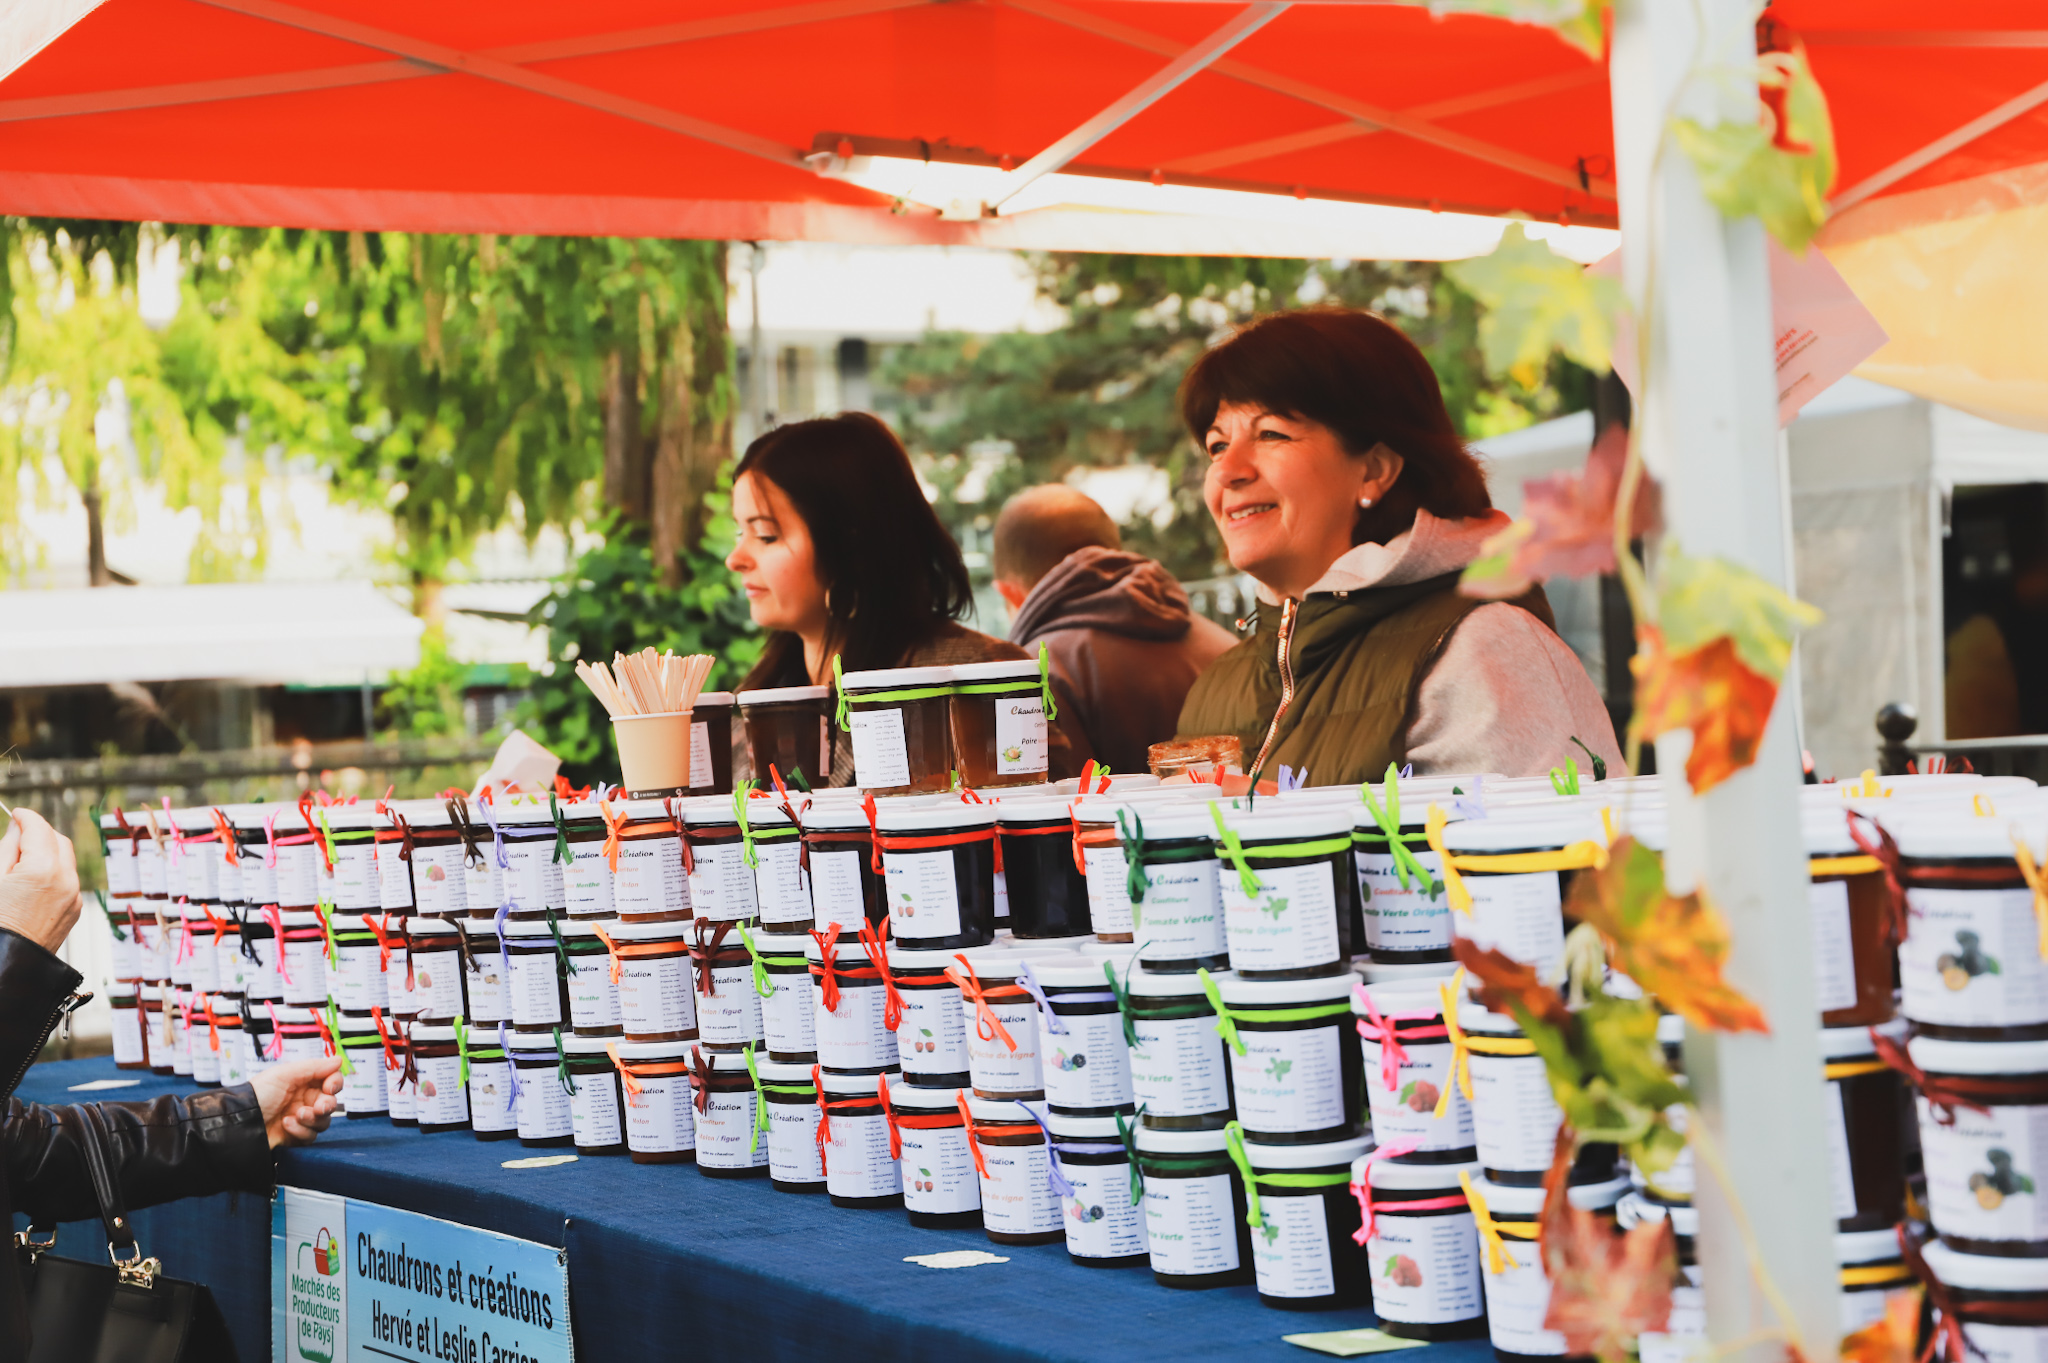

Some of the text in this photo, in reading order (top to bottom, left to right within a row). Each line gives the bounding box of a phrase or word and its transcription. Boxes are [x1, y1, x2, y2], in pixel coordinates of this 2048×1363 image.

[1022, 737, 1038, 745] Poire
[623, 848, 654, 858] Création
[1156, 874, 1199, 886] Création
[1374, 887, 1413, 896] Confiture
[1383, 908, 1410, 918] Verte
[1183, 914, 1215, 924] Verte
[1257, 925, 1293, 936] Origan
[624, 968, 652, 978] Création
[578, 994, 600, 1002] Menthe
[722, 1008, 742, 1016] figue
[831, 1010, 852, 1019] Noël
[996, 1052, 1006, 1060] de
[1010, 1051, 1036, 1061] vigne
[1148, 1074, 1174, 1083] Verte
[1260, 1087, 1296, 1098] Origan
[708, 1100, 742, 1112] Création
[699, 1118, 726, 1126] Confiture
[774, 1112, 805, 1123] Création
[720, 1134, 741, 1143] figue
[1002, 1195, 1024, 1203] vigne
[1159, 1232, 1184, 1242] Verte
[357, 1231, 553, 1330] Chaudrons et créations
[292, 1273, 340, 1302] Marchés des
[292, 1294, 340, 1324] Producteurs
[302, 1317, 331, 1346] de Pays
[372, 1300, 412, 1349] Hervé
[417, 1316, 431, 1355] et
[434, 1316, 477, 1363] Leslie
